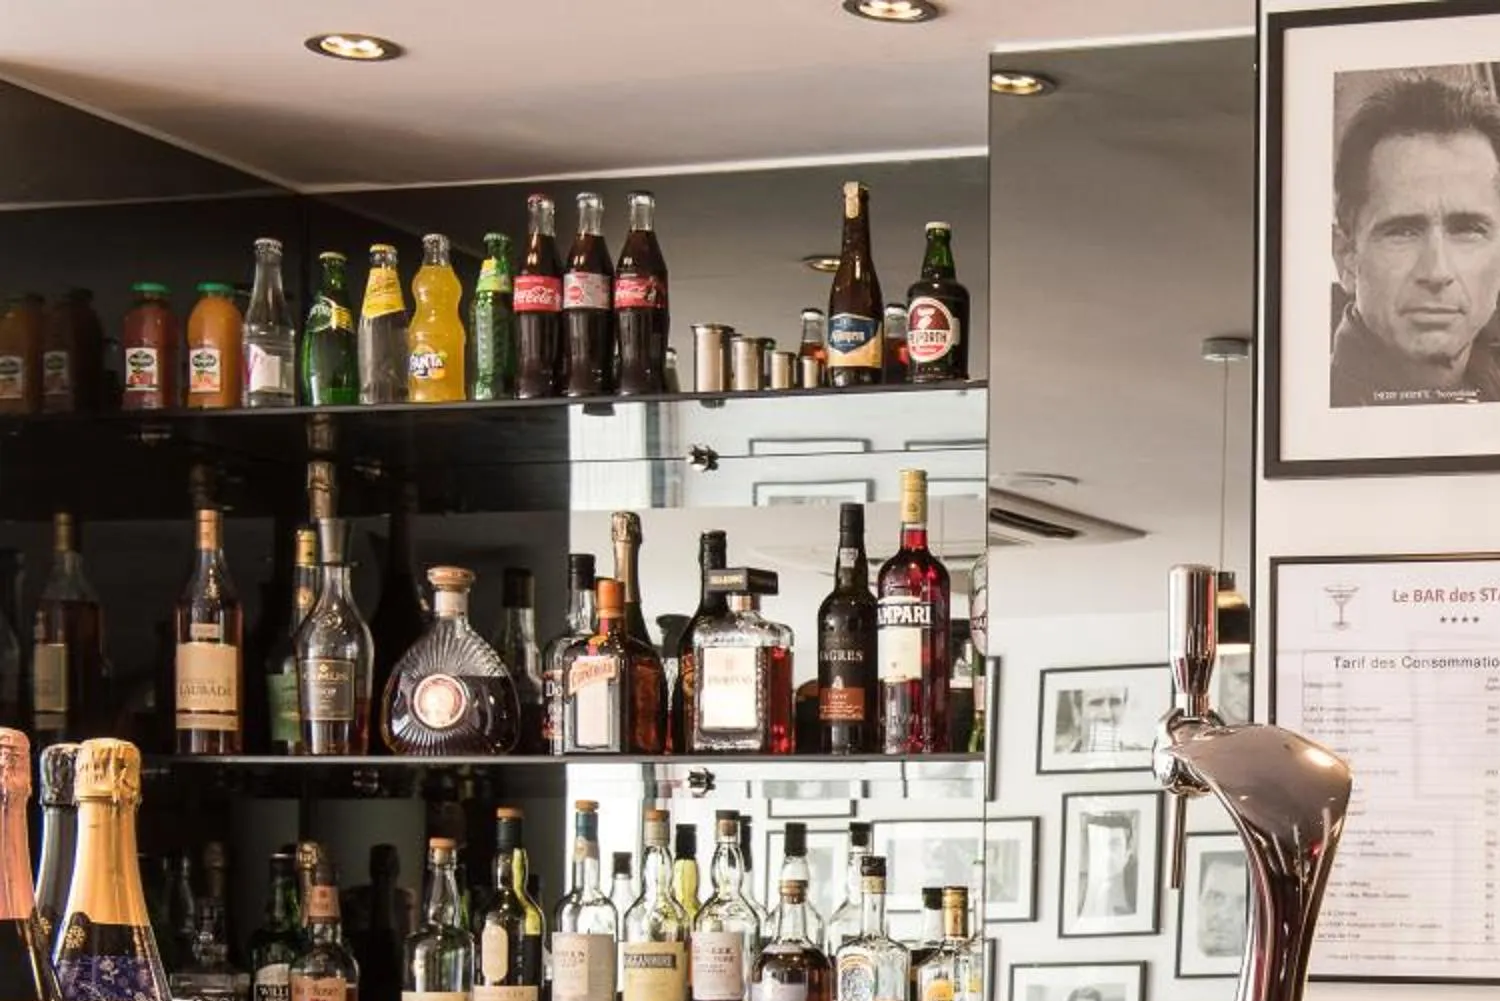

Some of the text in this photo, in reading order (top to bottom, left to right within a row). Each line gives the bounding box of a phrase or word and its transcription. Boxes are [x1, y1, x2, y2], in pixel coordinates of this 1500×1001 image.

[1392, 589, 1408, 602] Le
[1413, 589, 1445, 602] BAR
[1449, 587, 1475, 602] des
[877, 604, 931, 625] AMPARI
[1333, 656, 1366, 669] Tarif
[1371, 656, 1396, 669] des
